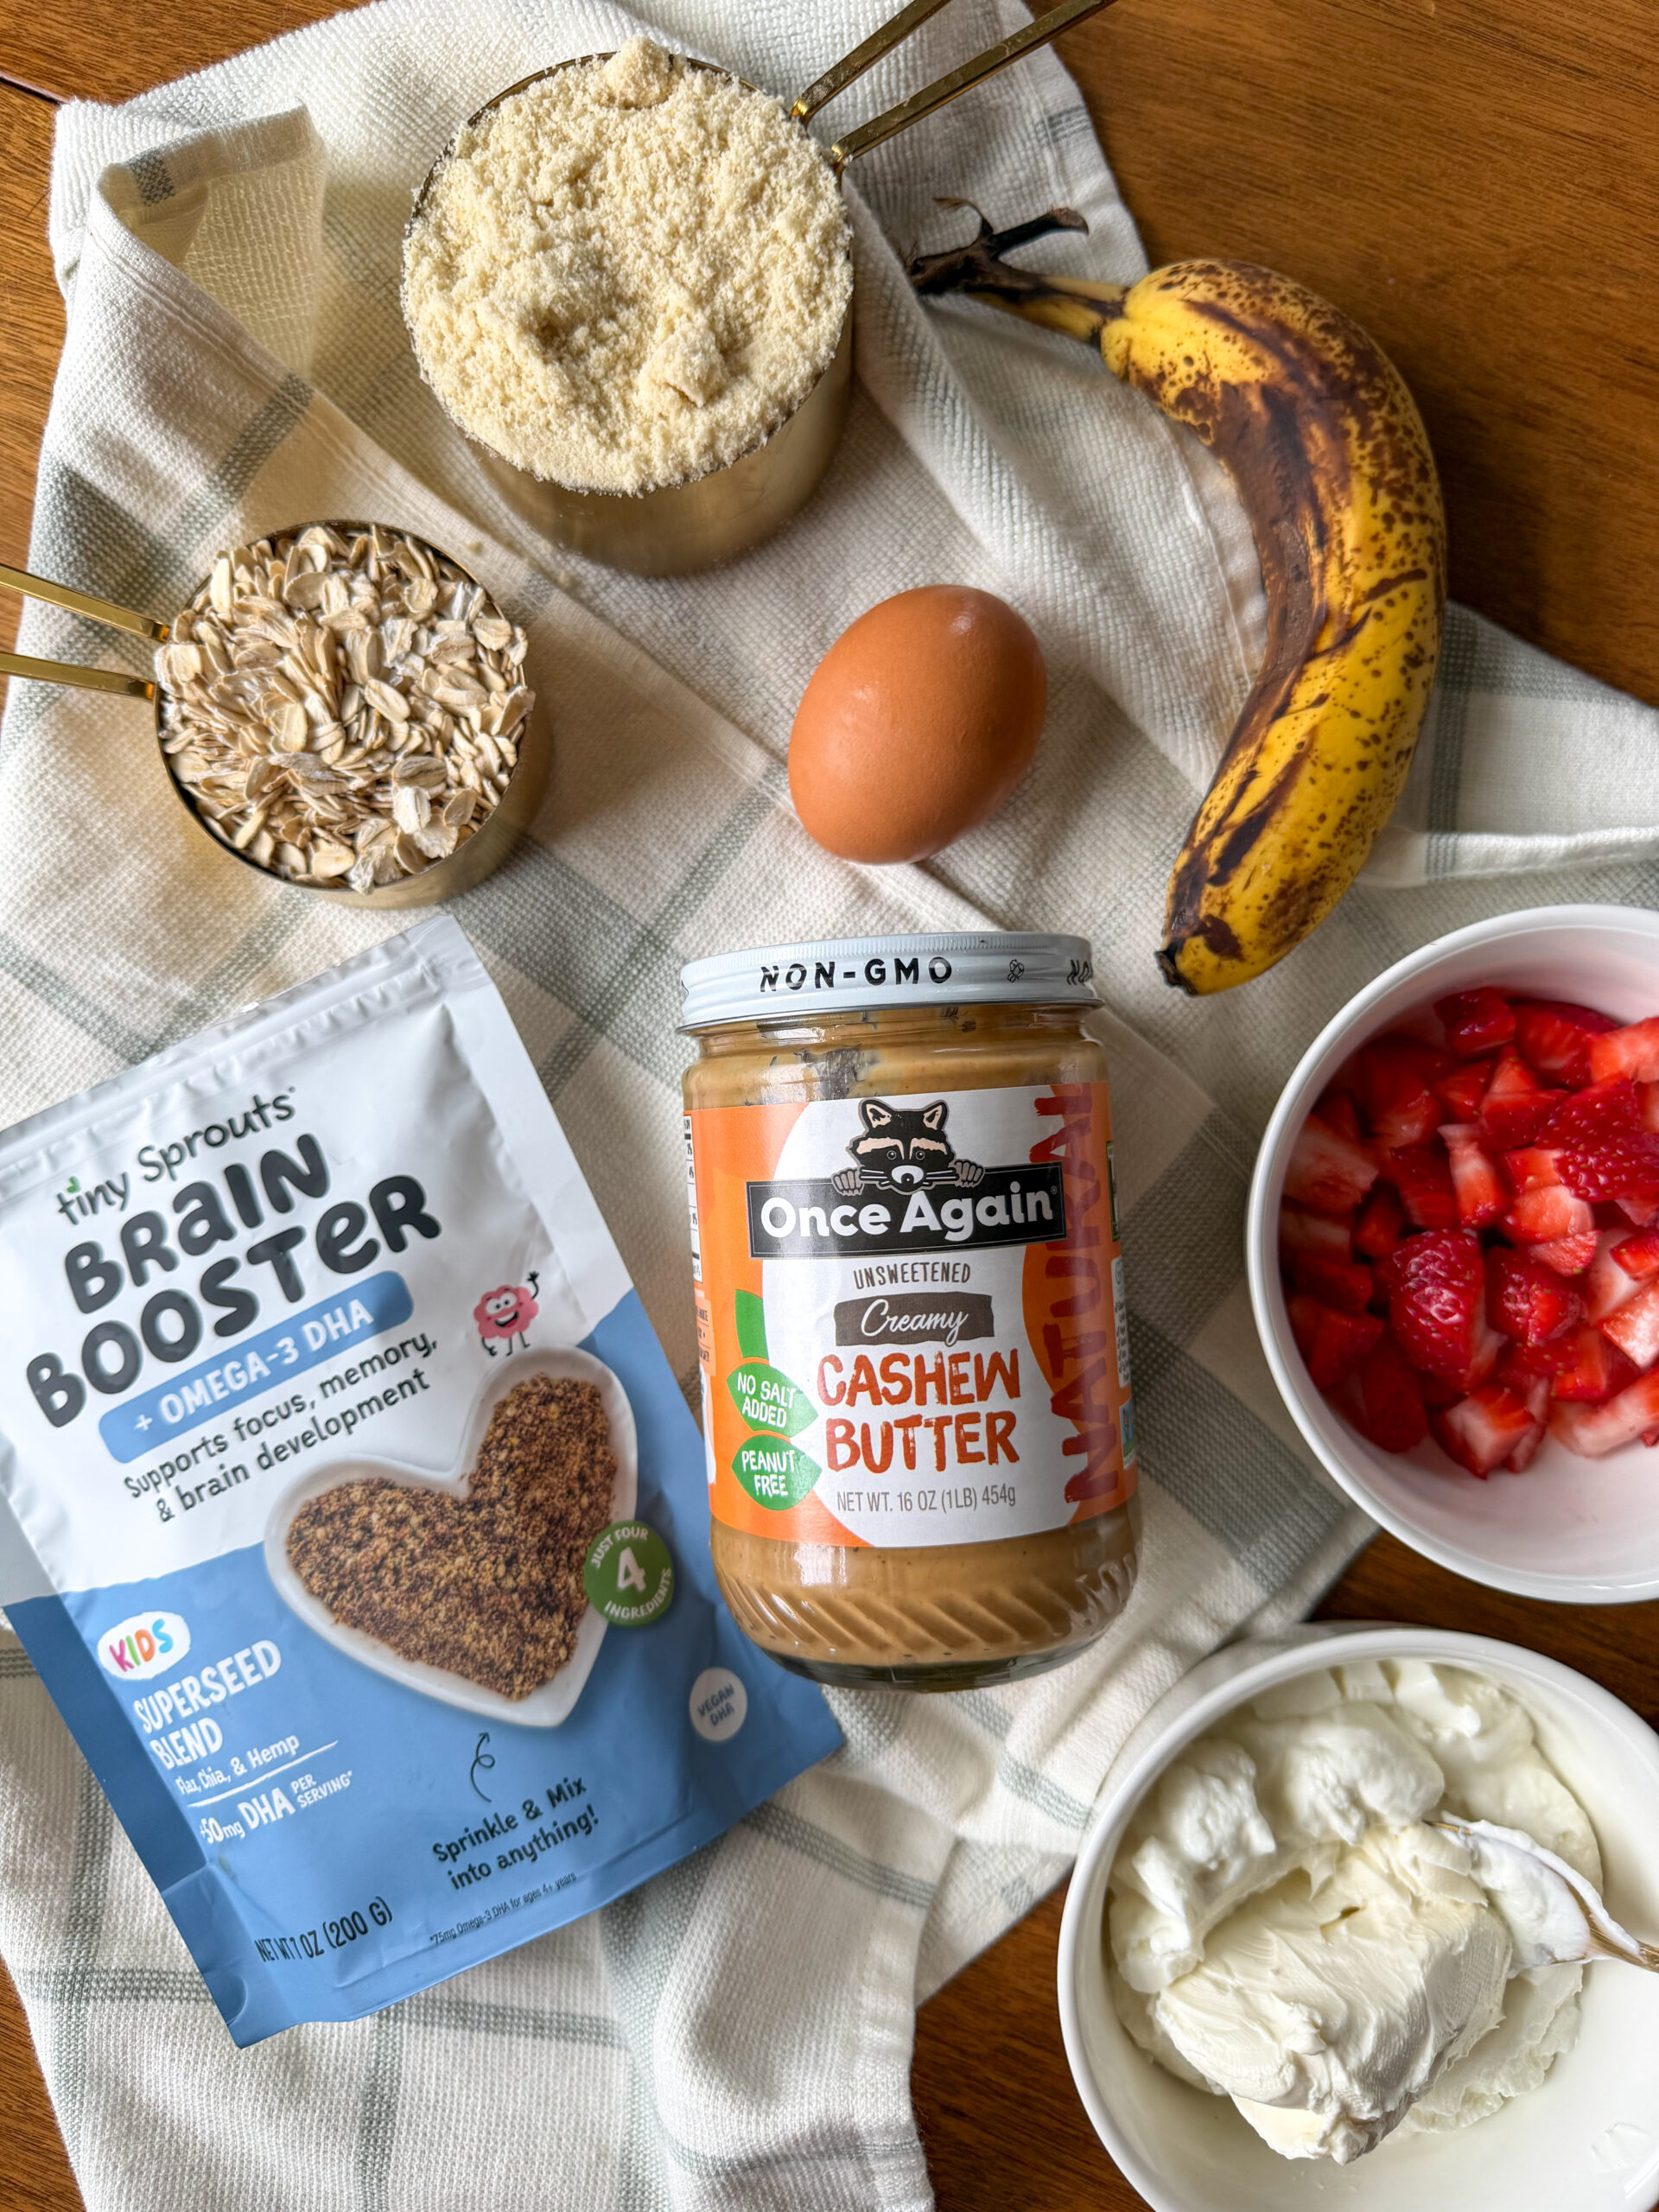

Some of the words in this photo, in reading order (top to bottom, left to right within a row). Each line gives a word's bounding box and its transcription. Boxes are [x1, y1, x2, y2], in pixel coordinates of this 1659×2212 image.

[759, 957, 952, 993] NON-GMO
[57, 1172, 130, 1226] tiny
[137, 1093, 296, 1182] Sprouts
[760, 1196, 892, 1239] Once
[854, 1262, 971, 1290] UNSWEETENED
[861, 1298, 969, 1346] Creamy
[160, 1337, 300, 1425] OMEGA-3
[302, 1299, 374, 1352] DHA
[817, 1348, 1020, 1408] CASHEW
[737, 1371, 756, 1395] NO
[760, 1380, 796, 1409] SALT
[741, 1395, 787, 1428] ADDED
[124, 1433, 229, 1500] Supports
[234, 1393, 316, 1443] focus,
[320, 1332, 438, 1401] memory,
[156, 1497, 175, 1523] &
[175, 1461, 251, 1510] brain
[257, 1368, 431, 1471] development
[741, 1449, 796, 1472] PEANUT
[826, 1410, 1020, 1474] BUTTER
[753, 1473, 789, 1497] FREE
[836, 1491, 863, 1511] NET
[867, 1491, 893, 1511] WT.
[897, 1491, 912, 1511] 16
[918, 1490, 938, 1510] OZ
[982, 1483, 1016, 1507] 454g
[591, 1534, 613, 1571] JUST
[614, 1526, 649, 1541] FOUR
[617, 1547, 646, 1592] 4
[605, 1567, 672, 1620] INGREDIENTS
[109, 1618, 174, 1672] KIDS
[133, 1640, 282, 1734] SUPERSEED
[697, 1683, 734, 1718] VEGAN
[709, 1701, 734, 1726] DHA
[149, 1717, 224, 1770] BLEND
[198, 1767, 232, 1789] Chia,
[231, 1757, 248, 1776] &
[247, 1734, 300, 1769] Hemp
[238, 1787, 296, 1830] DHA
[290, 1773, 316, 1795] PER
[432, 1812, 518, 1862] Sprinkle
[522, 1798, 543, 1821] &
[546, 1777, 587, 1808] Mix
[447, 1863, 492, 1891] into
[497, 1802, 600, 1862] anything!
[456, 1910, 492, 1934] Omega-3
[493, 1902, 511, 1917] DHA
[510, 1896, 522, 1908] for
[523, 1888, 543, 1904] ages
[555, 1872, 577, 1891] years
[254, 1937, 280, 1963] NET
[273, 1937, 296, 1961] WT
[300, 1929, 324, 1959] OZ
[322, 1910, 368, 1949] (200
[369, 1896, 393, 1927] G)
